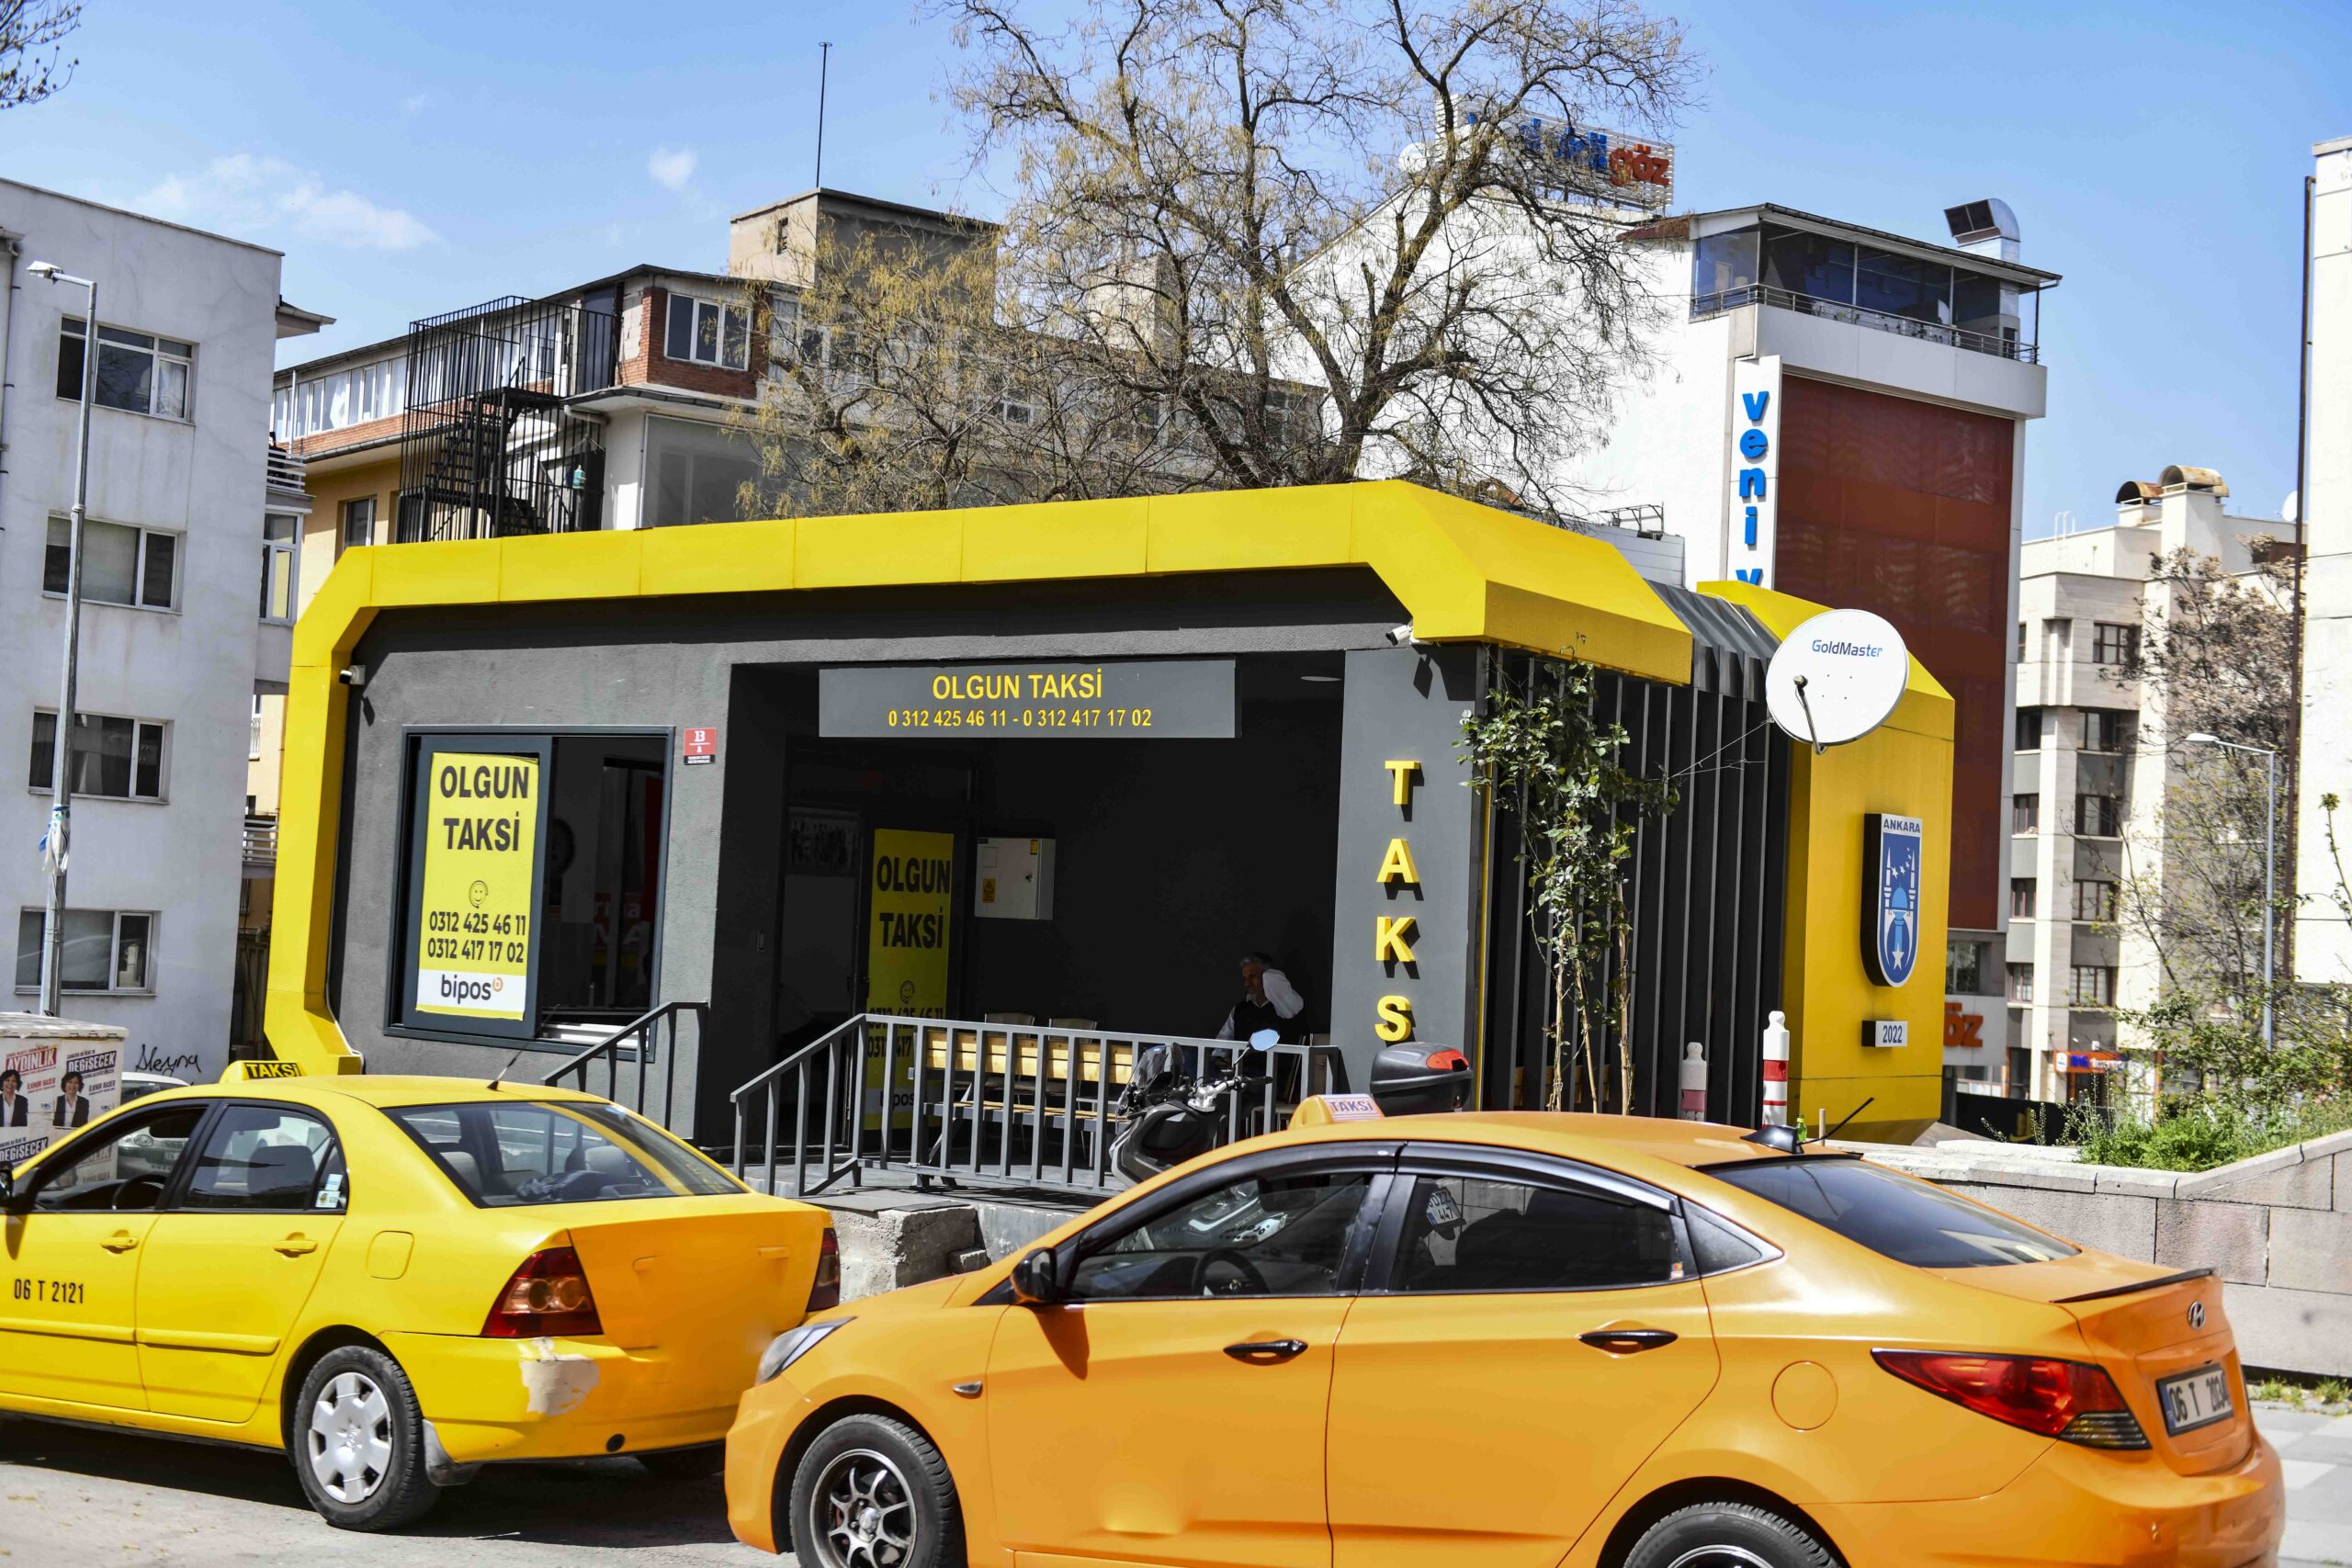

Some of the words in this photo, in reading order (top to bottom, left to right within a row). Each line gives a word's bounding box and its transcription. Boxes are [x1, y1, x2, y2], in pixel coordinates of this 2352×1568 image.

[1738, 390, 1770, 545] veni
[1812, 639, 1883, 657] GoldMaster
[933, 674, 1020, 699] OLGUN
[1028, 668, 1102, 698] TAKSİ
[888, 710, 898, 727] 0
[902, 710, 929, 727] 312
[933, 710, 961, 727] 425
[966, 710, 985, 727] 46
[990, 709, 1006, 726] 11
[1023, 709, 1032, 726] 0
[1037, 709, 1066, 726] 312
[1071, 709, 1101, 726] 417
[1106, 708, 1125, 726] 17
[1131, 708, 1152, 726] 02
[440, 765, 529, 798] OLGUN
[443, 810, 520, 852] TAKSİ
[1883, 818, 1920, 833] ANKARA
[876, 855, 951, 894] OLGUN
[429, 911, 458, 932] 0312
[463, 913, 489, 933] 425
[492, 914, 511, 935] 46
[515, 915, 526, 936] 11
[879, 907, 944, 949] TAKSİ
[427, 938, 458, 959] 0312
[461, 940, 485, 961] 417
[489, 941, 503, 962] 17
[507, 942, 524, 964] 02
[441, 974, 492, 1004] bipos
[1883, 1024, 1903, 1043] 2022
[14, 1279, 31, 1300] 06
[38, 1280, 46, 1301] T
[51, 1280, 84, 1304] 2121
[2169, 1385, 2188, 1422] 06
[2188, 1382, 2200, 1417] T
